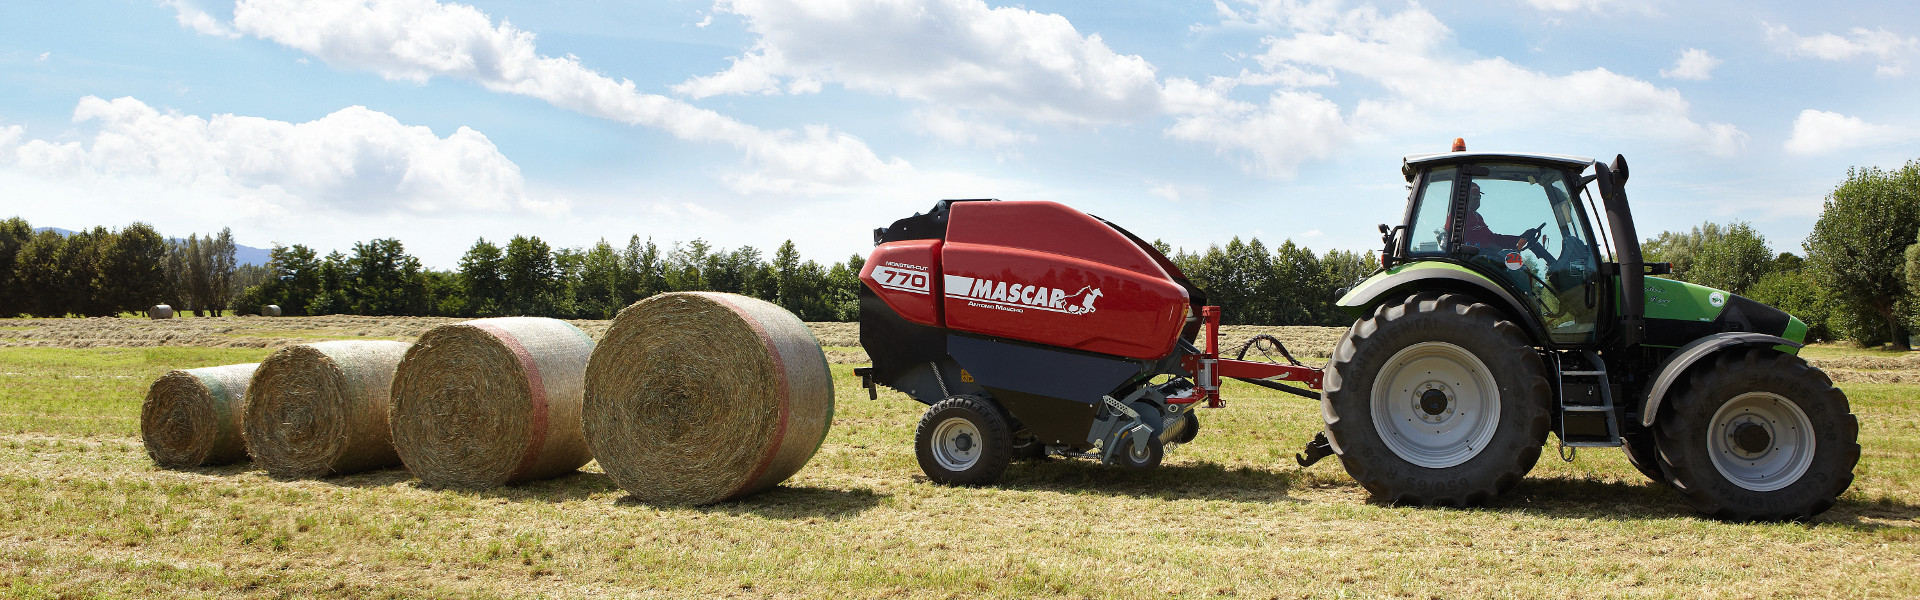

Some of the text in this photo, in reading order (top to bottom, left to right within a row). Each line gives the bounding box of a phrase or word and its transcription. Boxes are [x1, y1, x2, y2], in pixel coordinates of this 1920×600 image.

[1506, 253, 1523, 266] 24
[884, 270, 927, 288] 770
[970, 278, 1066, 309] MASCAR
